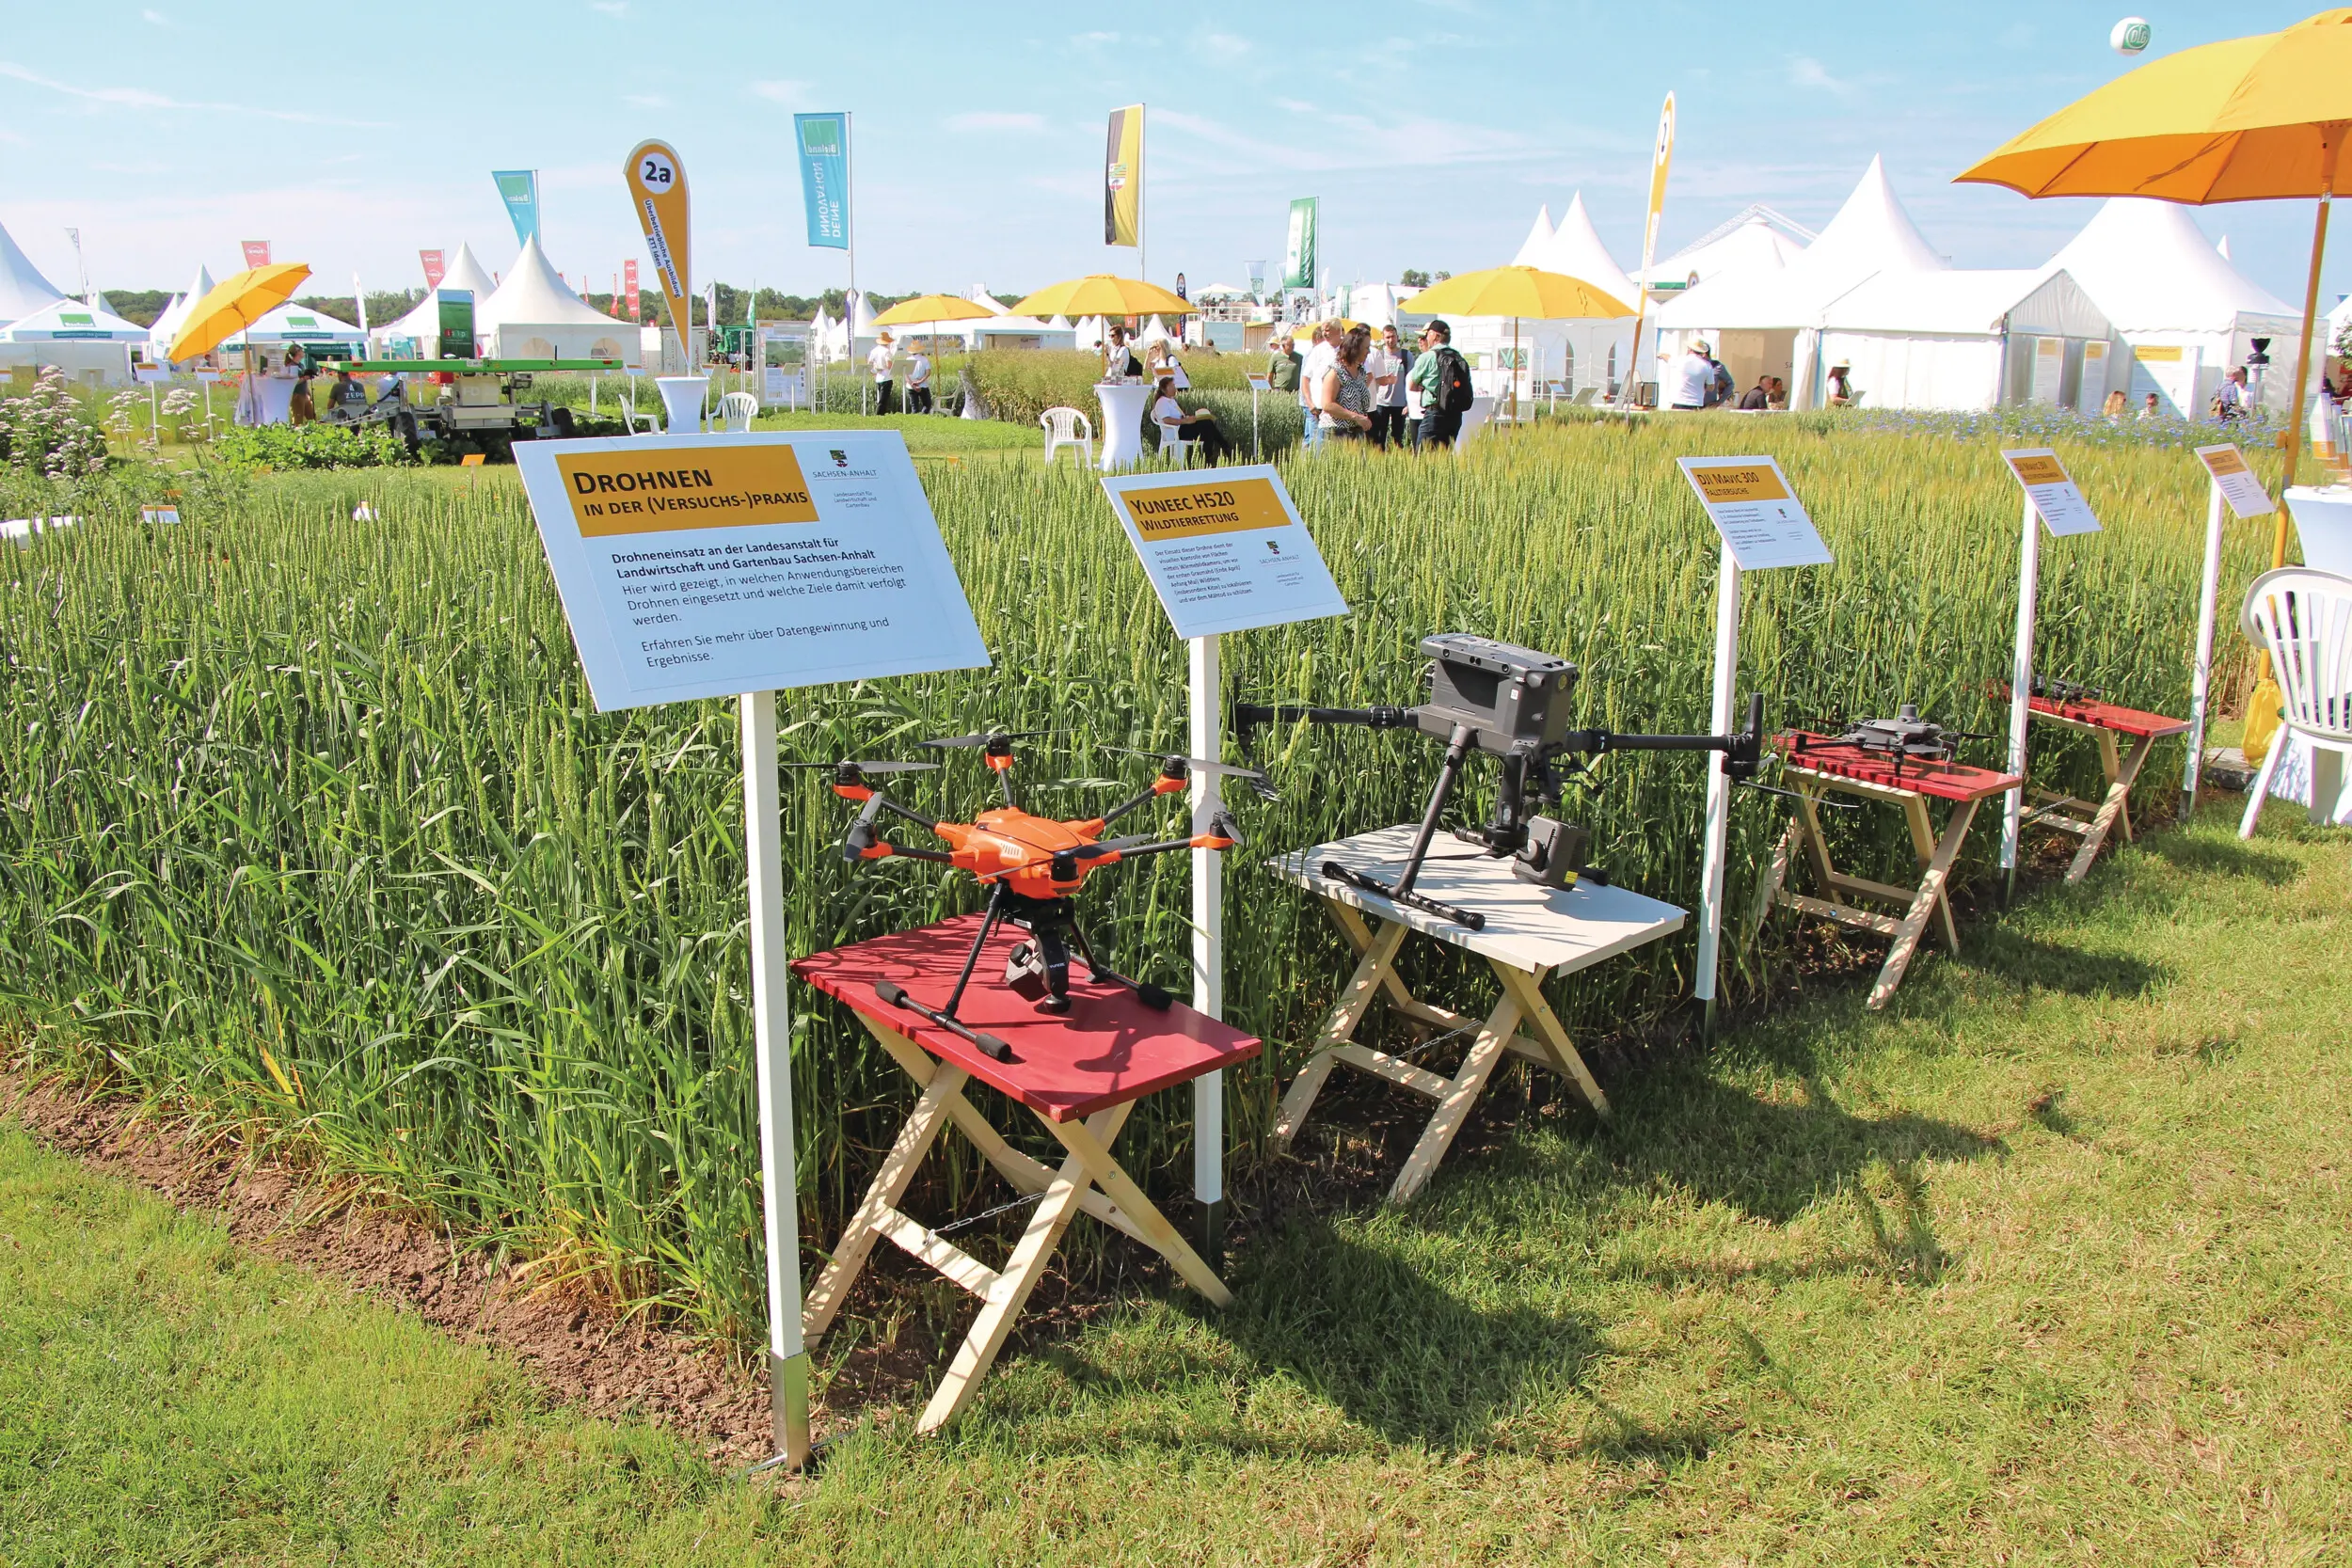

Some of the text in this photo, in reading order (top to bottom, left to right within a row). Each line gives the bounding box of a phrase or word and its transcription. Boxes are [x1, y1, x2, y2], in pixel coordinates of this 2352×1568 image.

[645, 161, 672, 183] 2a
[644, 199, 667, 259] Überbetriebliche
[647, 237, 658, 249] ZTT
[652, 248, 661, 267] Iden
[664, 259, 680, 299] Ausbildung
[572, 468, 714, 495] DROHNEN
[812, 469, 877, 478] SACHSEN-ANHALT
[1740, 471, 1759, 483] 300
[609, 500, 644, 515] DER
[1192, 491, 1235, 508] H520
[612, 537, 839, 564] Drohneneinsatz an der Landesanstalt für
[616, 549, 876, 578] Landwirtschaft und Gartenbau Sachsen-Anhalt
[622, 564, 904, 595] Hier wird gezeigt, in welchen Anwendungsbereichen
[628, 578, 907, 610] Drohnen eingesetzt und welche Ziele damit verfolgt
[632, 612, 682, 626] werden.
[641, 617, 889, 652] Erfahren Sie mehr über Datengewinnung und
[646, 652, 714, 668] Ergebnisse.
